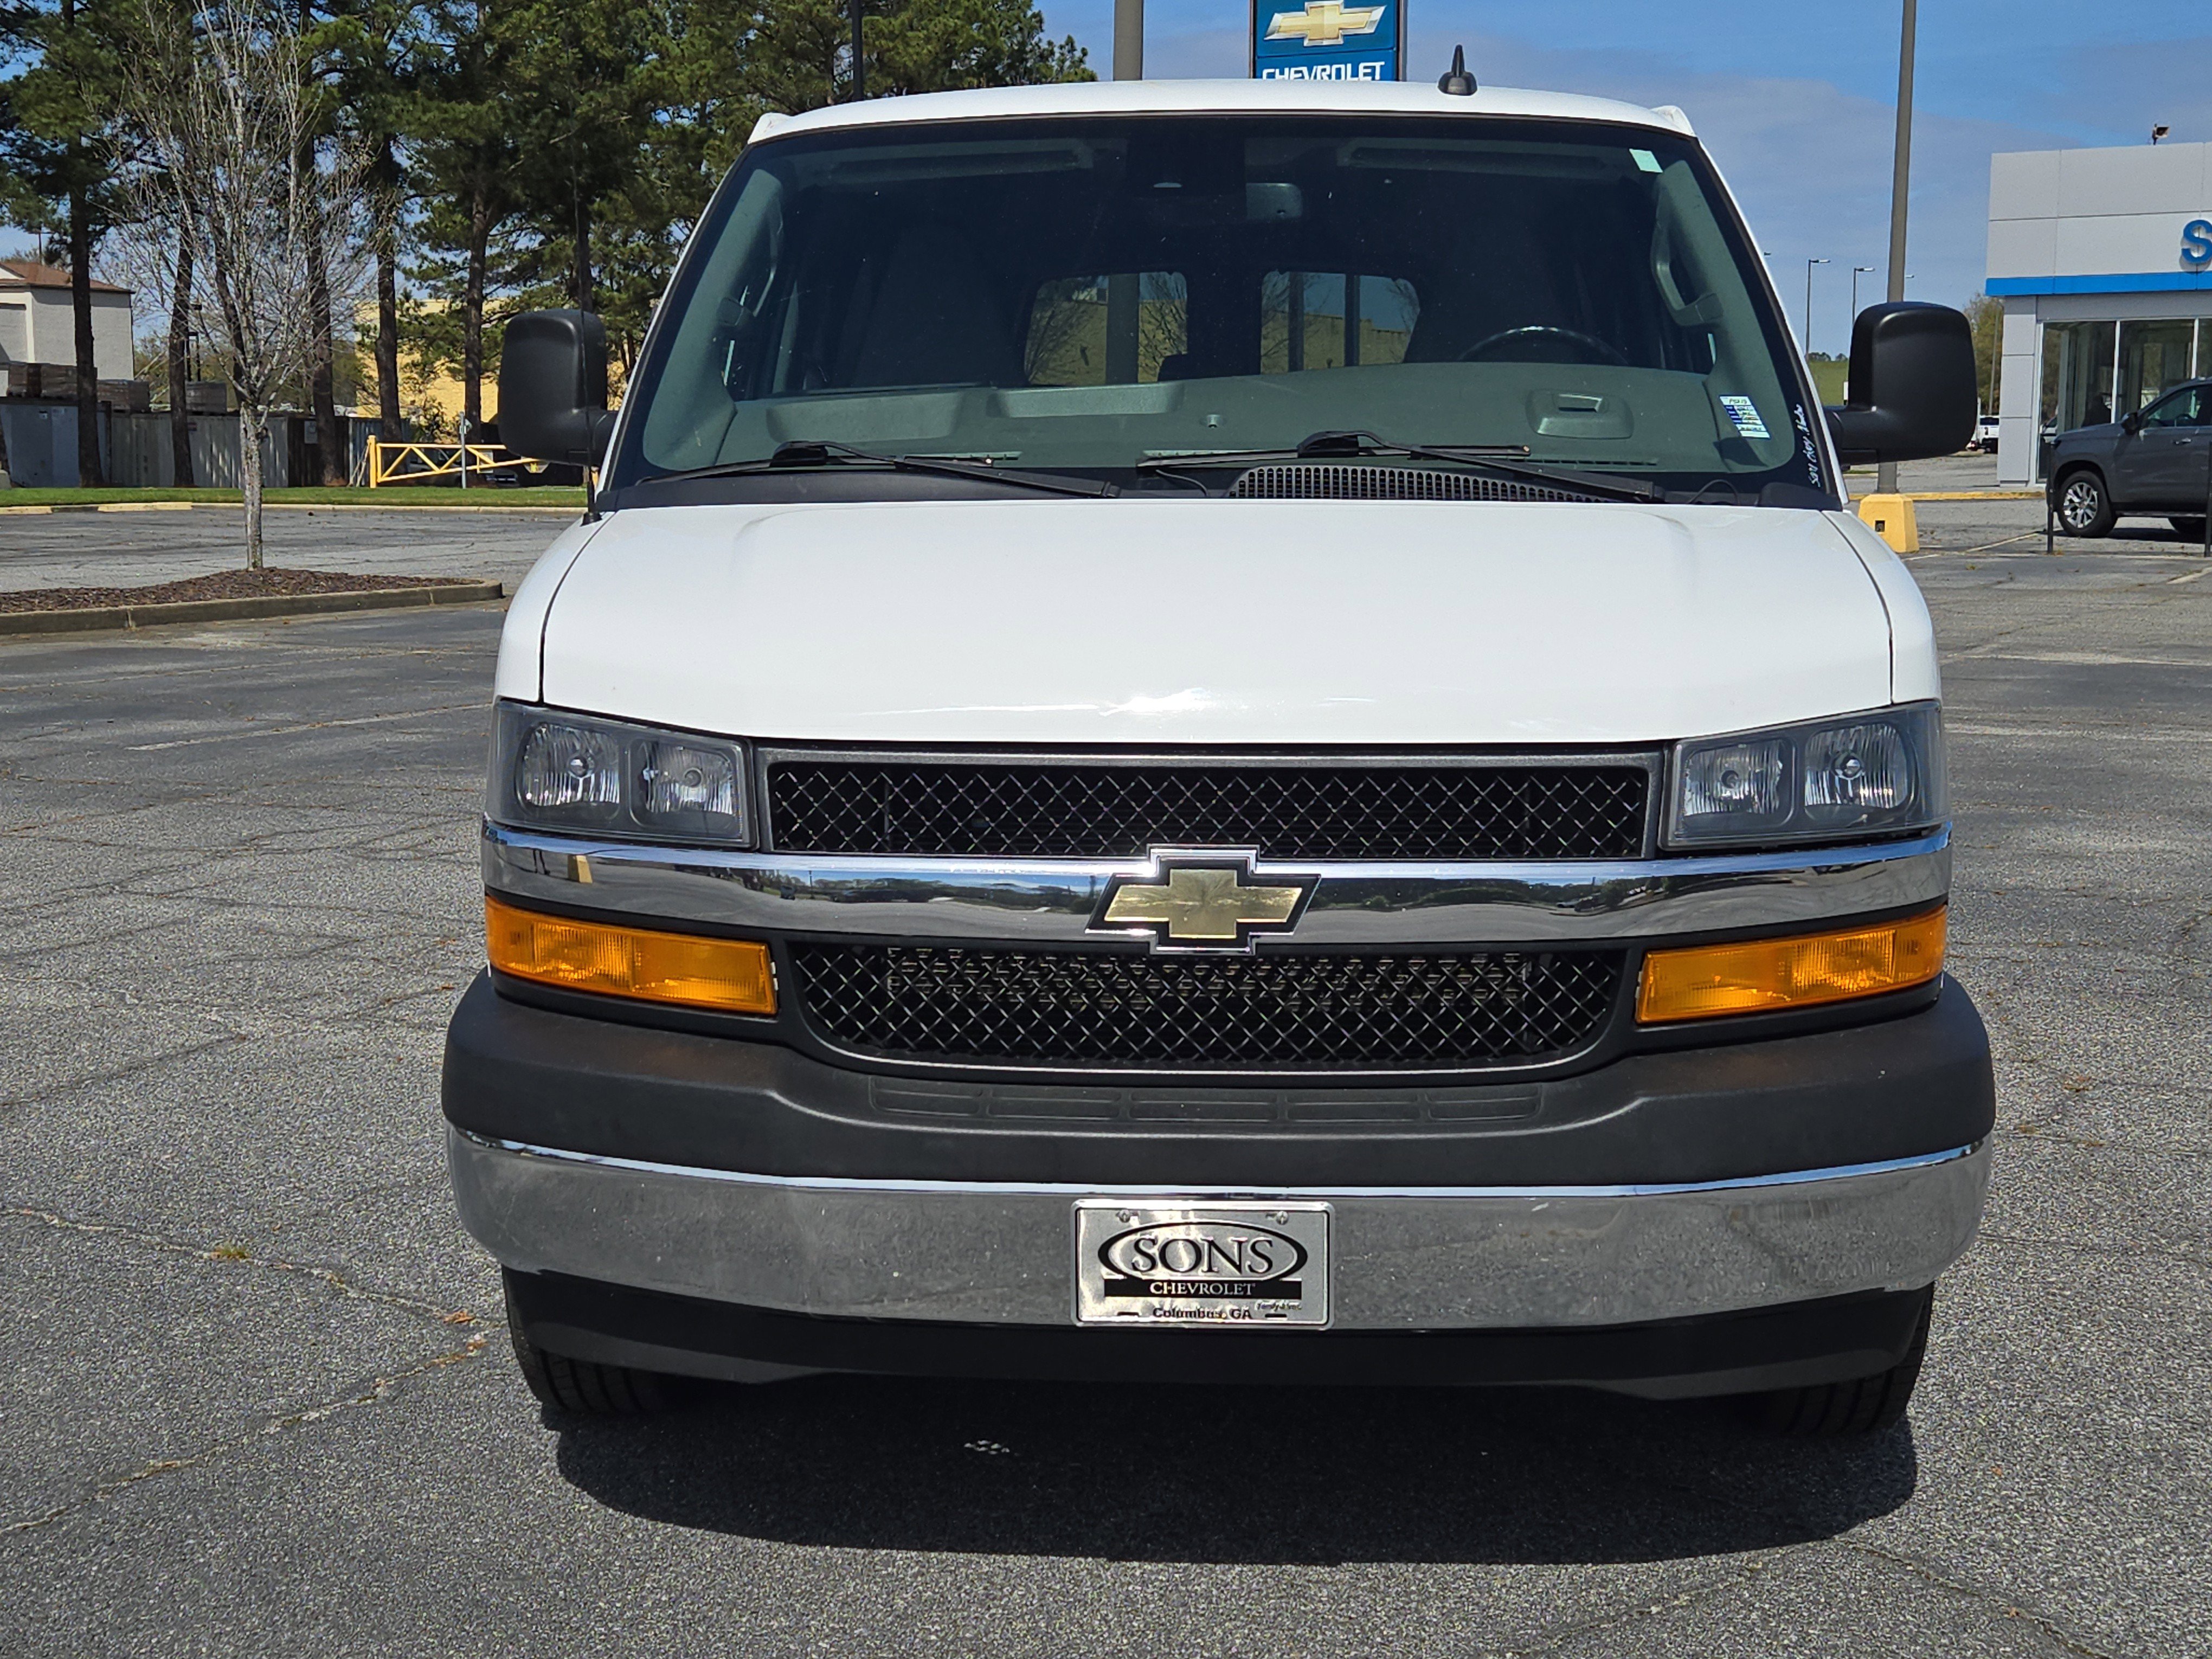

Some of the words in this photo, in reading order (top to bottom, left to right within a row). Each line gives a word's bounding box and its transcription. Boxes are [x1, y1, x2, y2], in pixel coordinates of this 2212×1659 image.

[1262, 61, 1385, 81] CHEVROLET
[1131, 1238, 1273, 1275] SONS
[1149, 1282, 1252, 1296] CHEVROLET
[1230, 1308, 1252, 1320] GA
